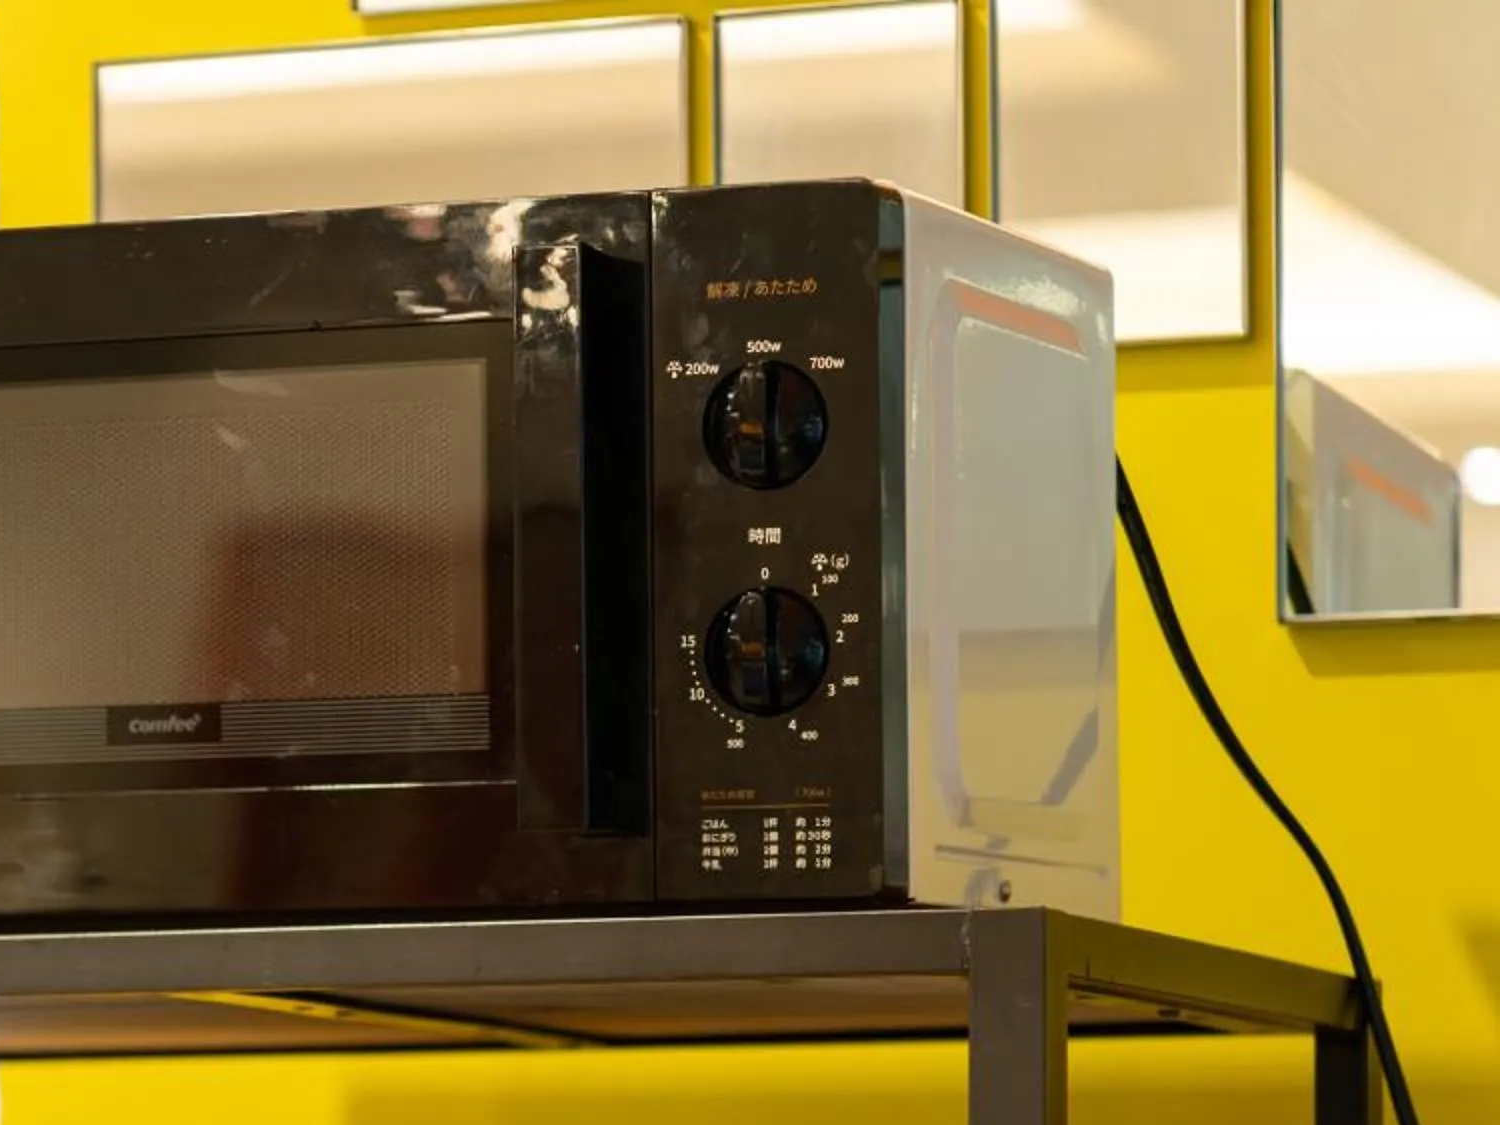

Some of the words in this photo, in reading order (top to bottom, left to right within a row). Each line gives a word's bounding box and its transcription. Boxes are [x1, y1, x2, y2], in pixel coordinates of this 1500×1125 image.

[746, 340, 781, 353] 500w
[685, 361, 720, 376] 200w
[809, 356, 845, 369] 700w
[748, 527, 781, 545] 時間
[760, 567, 770, 579] 0
[811, 584, 819, 597] 1
[680, 635, 697, 648] 15
[835, 630, 845, 644] 2
[689, 687, 705, 701] 10
[827, 684, 836, 697] 3
[735, 719, 745, 733] 5
[787, 719, 797, 731] 4
